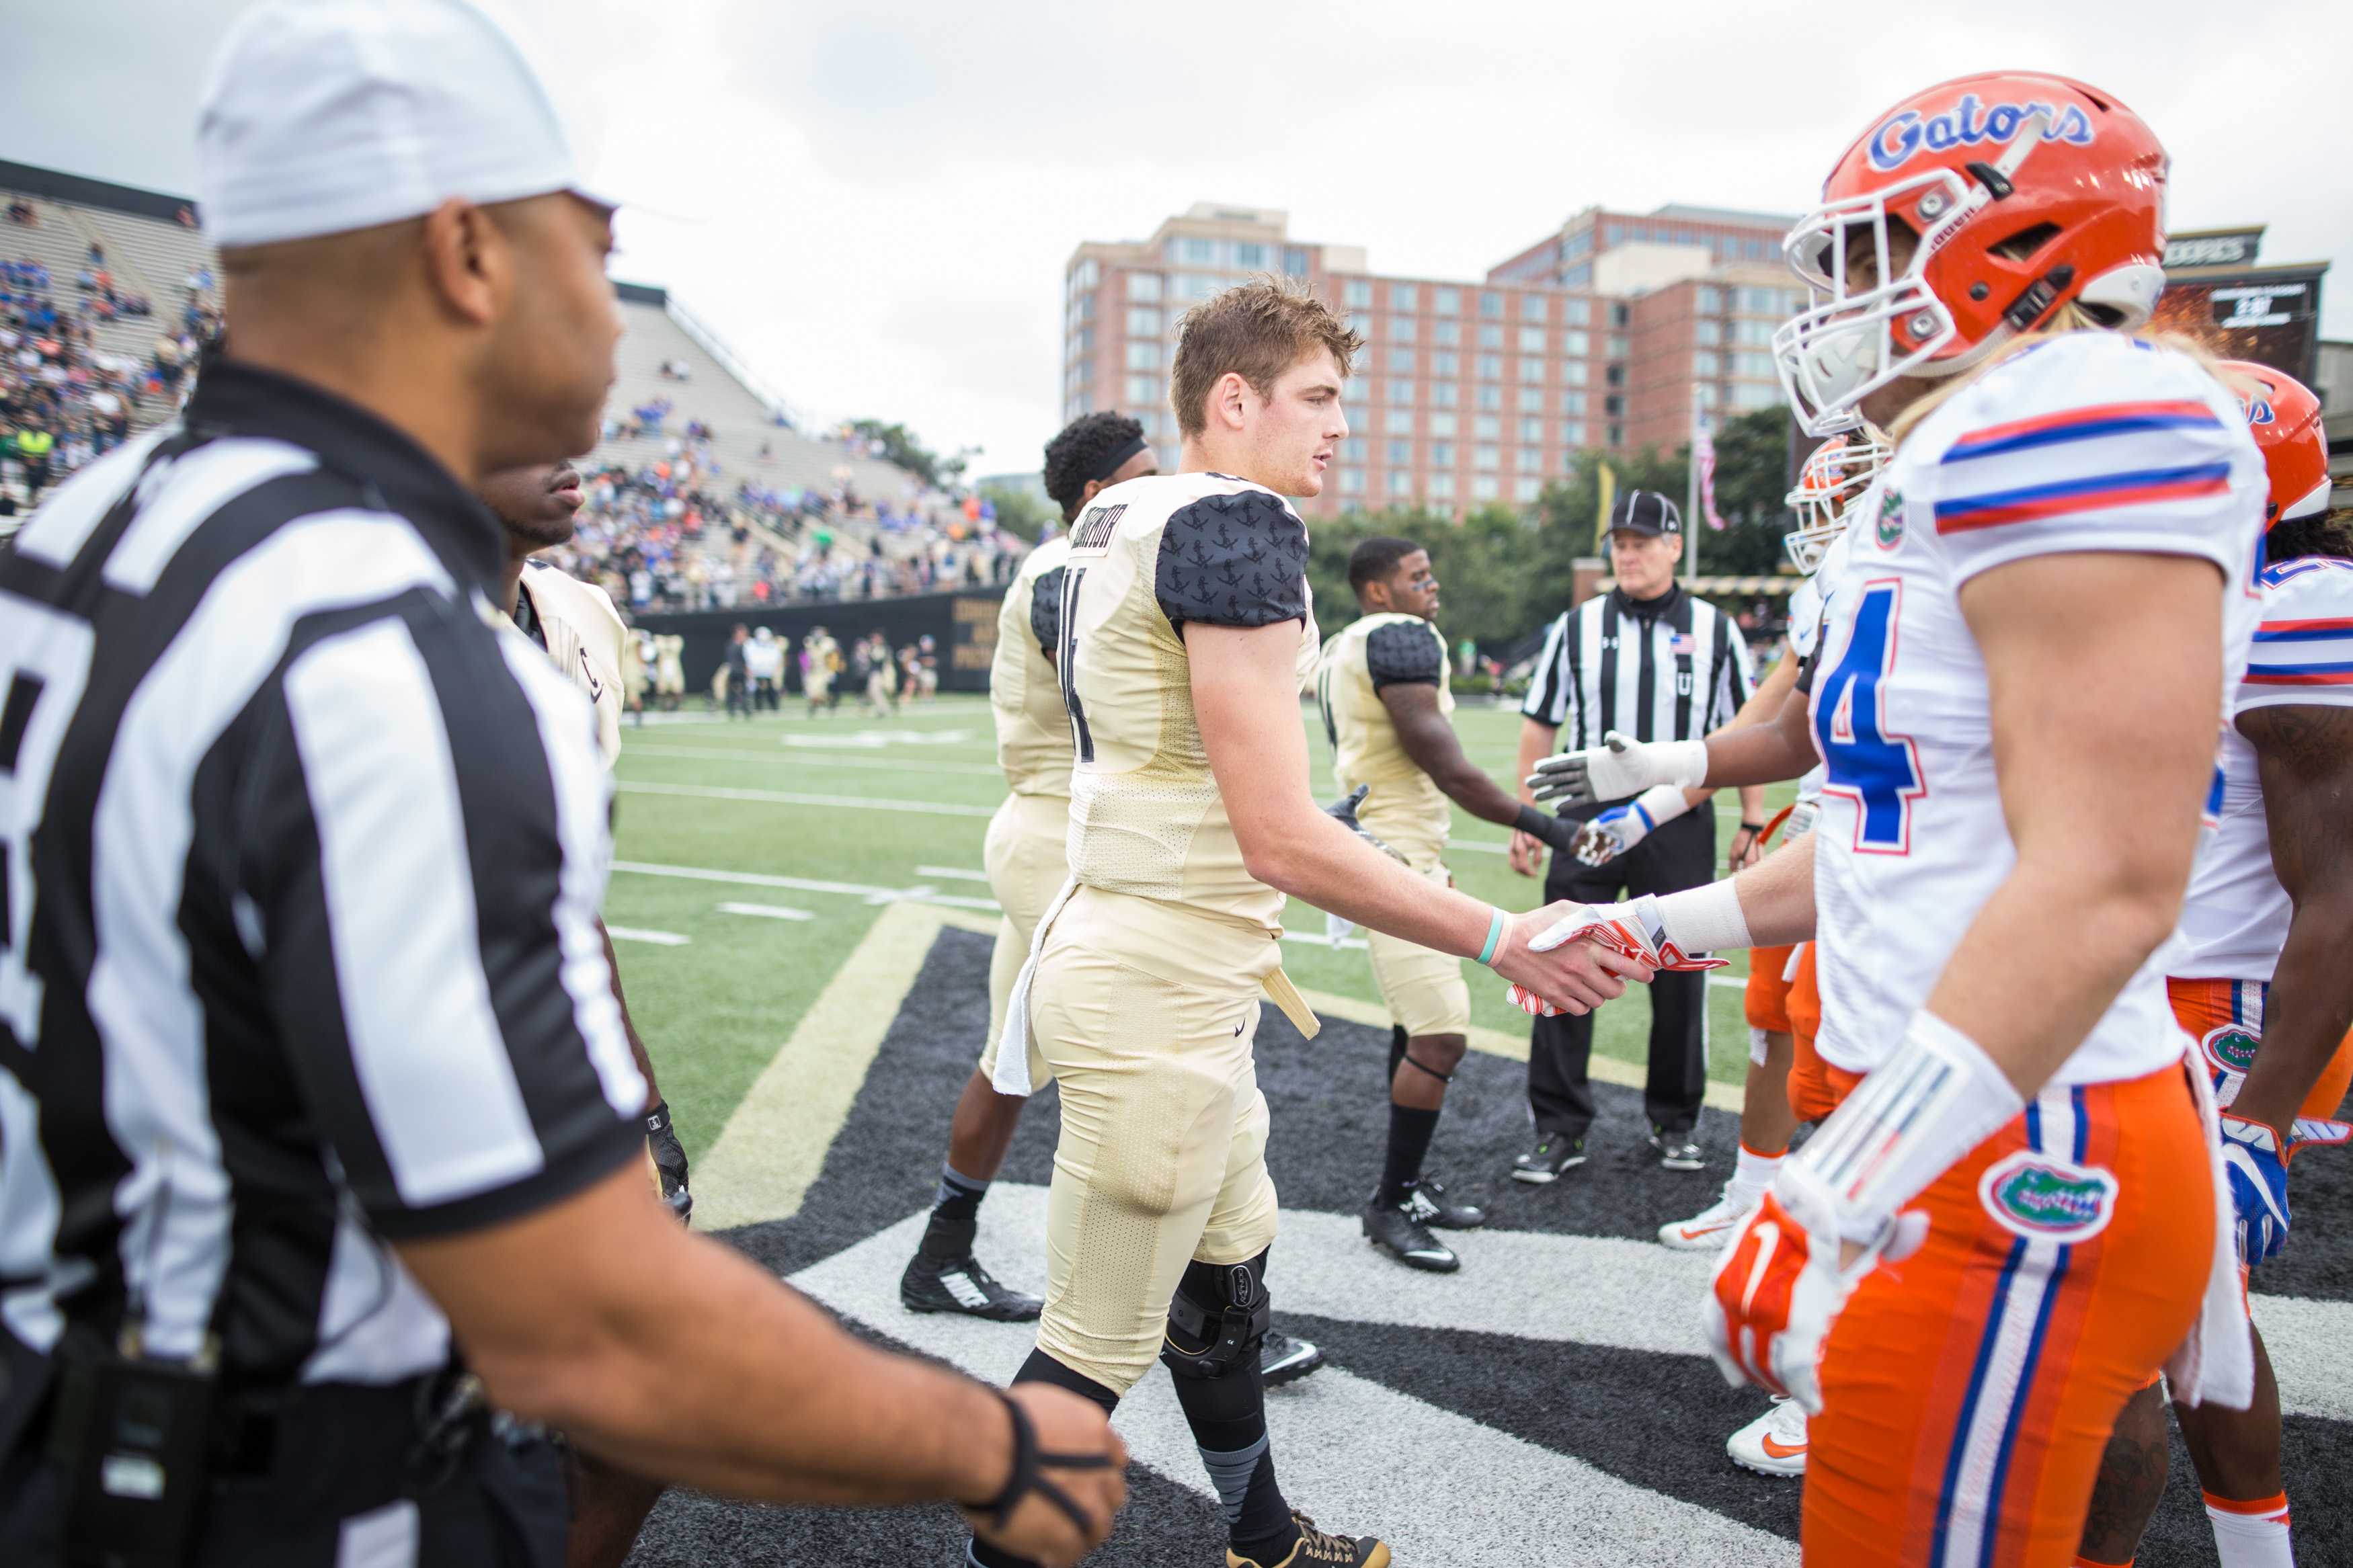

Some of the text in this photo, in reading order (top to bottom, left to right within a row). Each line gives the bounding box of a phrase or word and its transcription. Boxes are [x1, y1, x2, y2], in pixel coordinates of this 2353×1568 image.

[1868, 93, 2093, 171] Gators
[1677, 672, 1692, 696] U
[1808, 577, 1928, 856] 4
